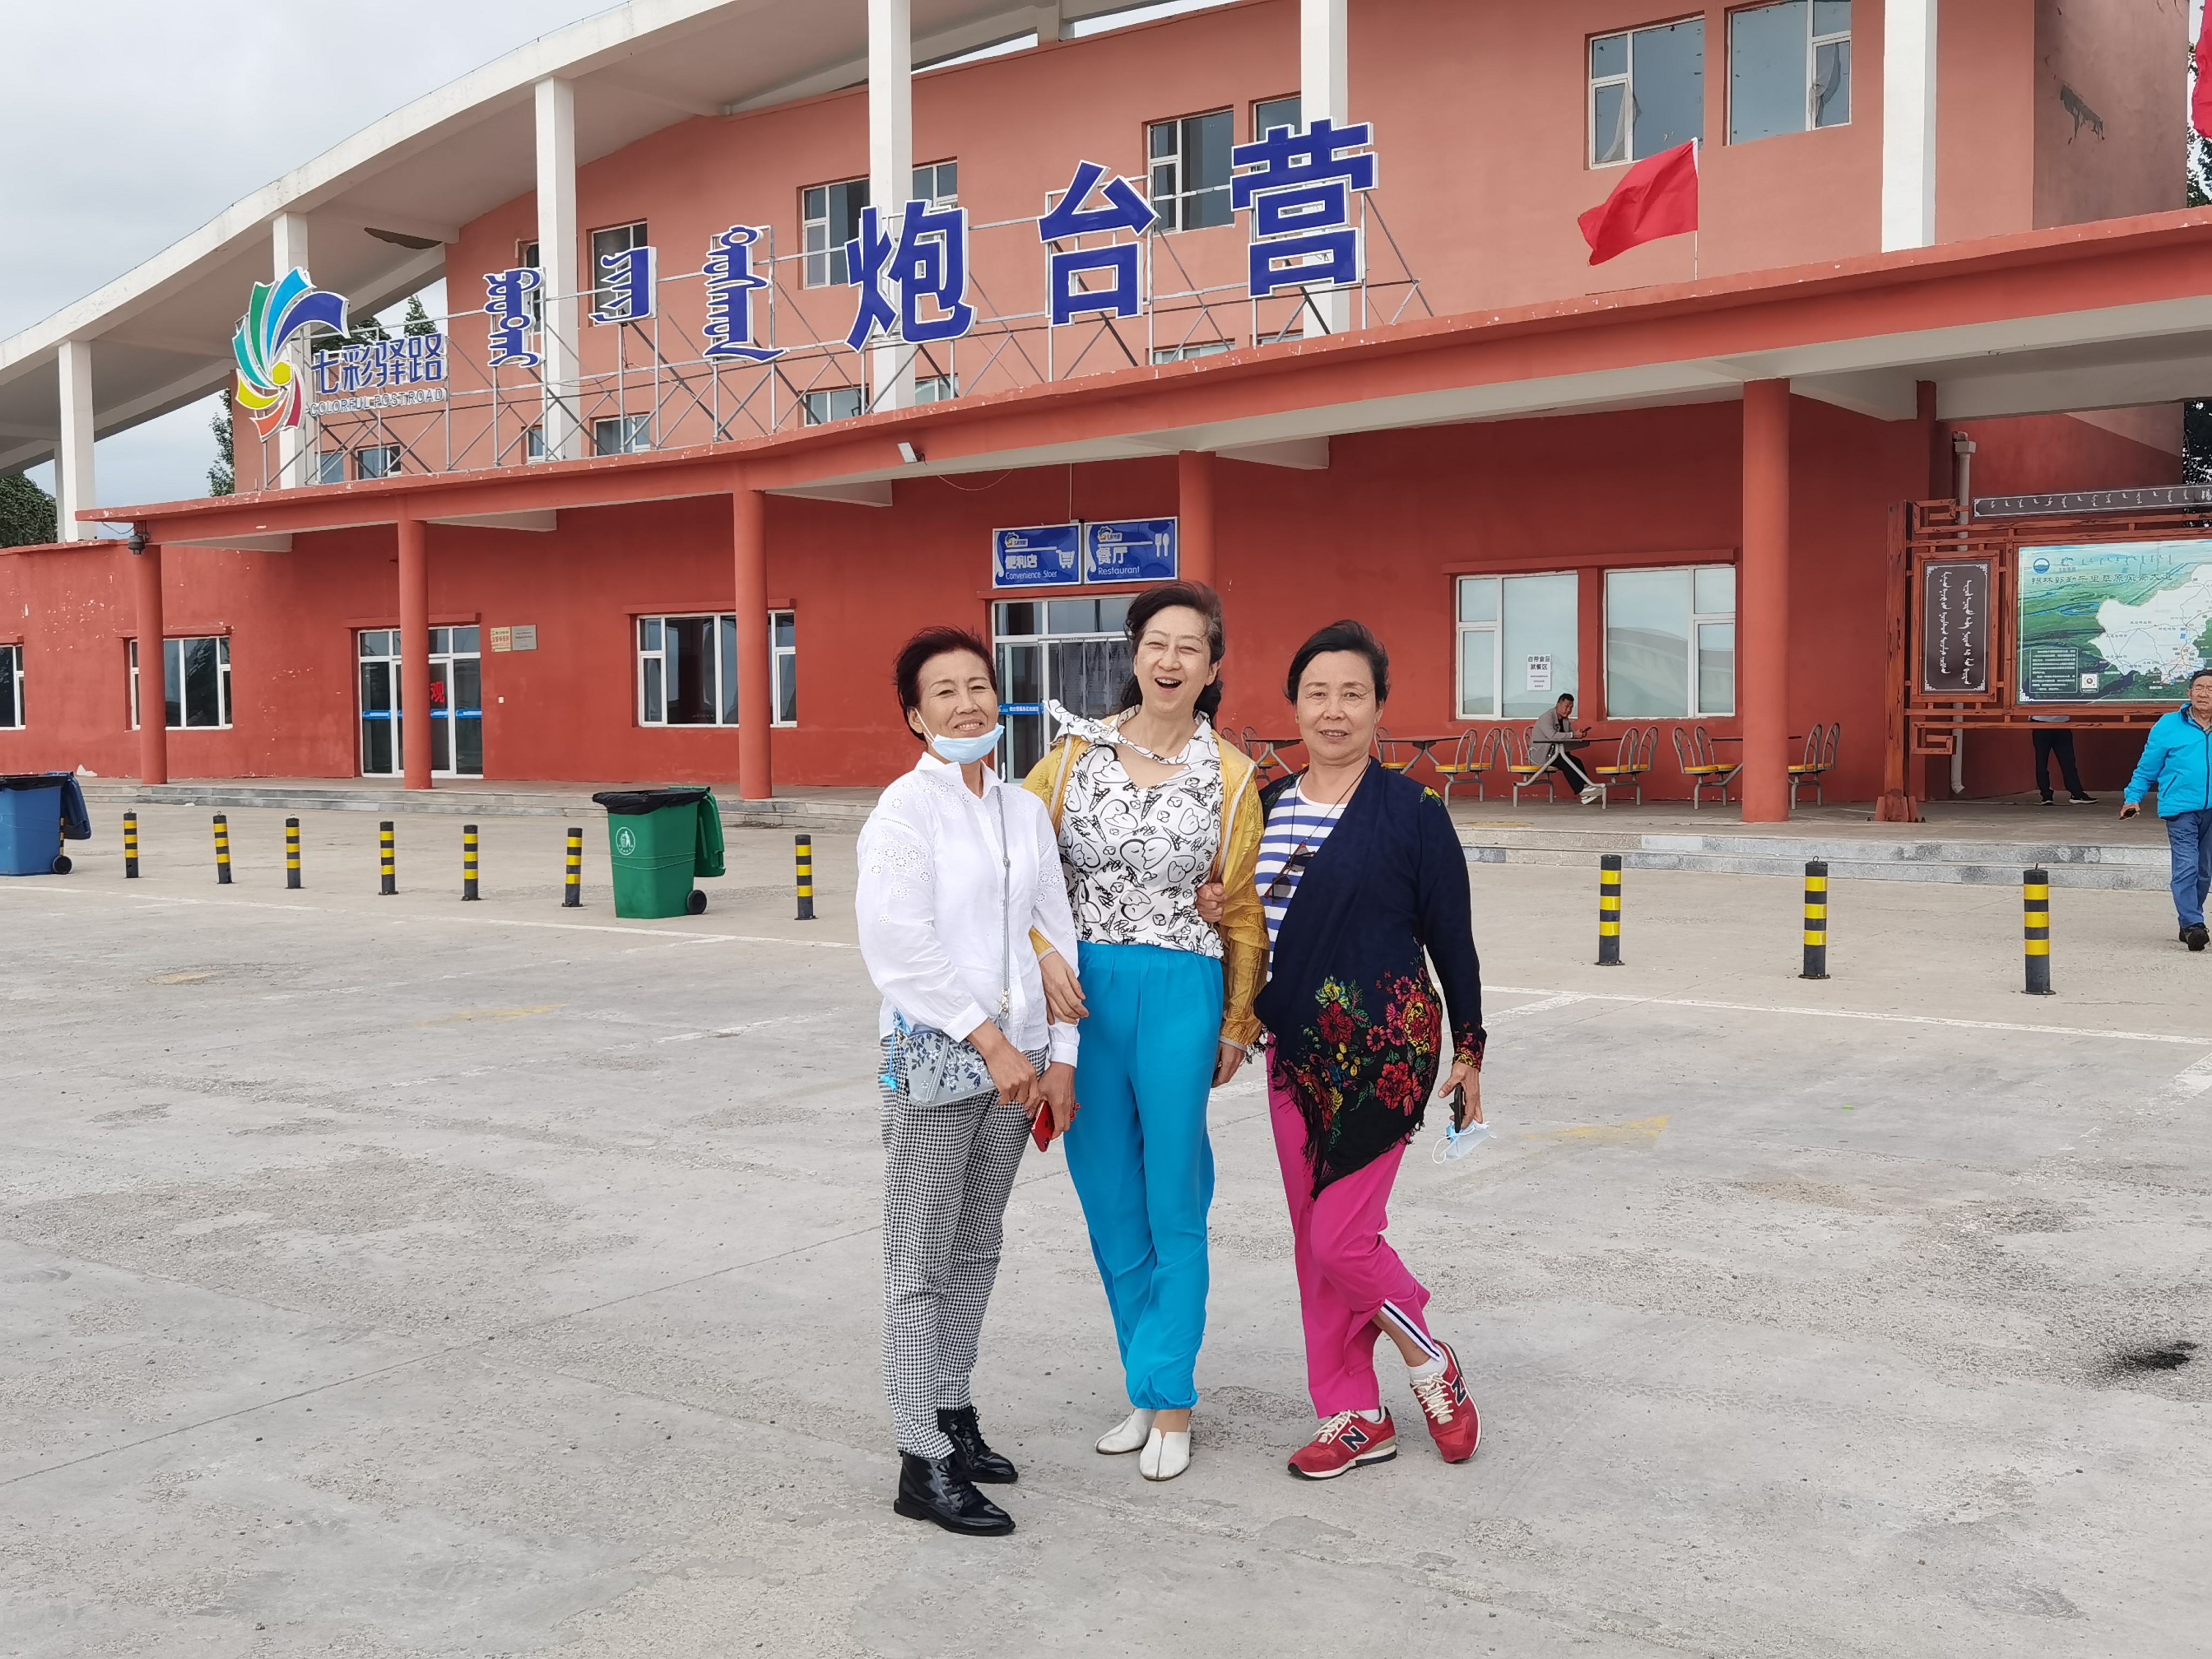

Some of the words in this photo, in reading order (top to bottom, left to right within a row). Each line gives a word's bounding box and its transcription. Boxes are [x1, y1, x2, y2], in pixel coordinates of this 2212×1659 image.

[845, 116, 1378, 353] 炮台营
[311, 333, 444, 394] 七彩驿路
[310, 399, 370, 416] COLORFUL
[1096, 546, 1128, 565] 餐厅
[1098, 566, 1139, 576] Restaurant
[1339, 1425, 1369, 1453] N
